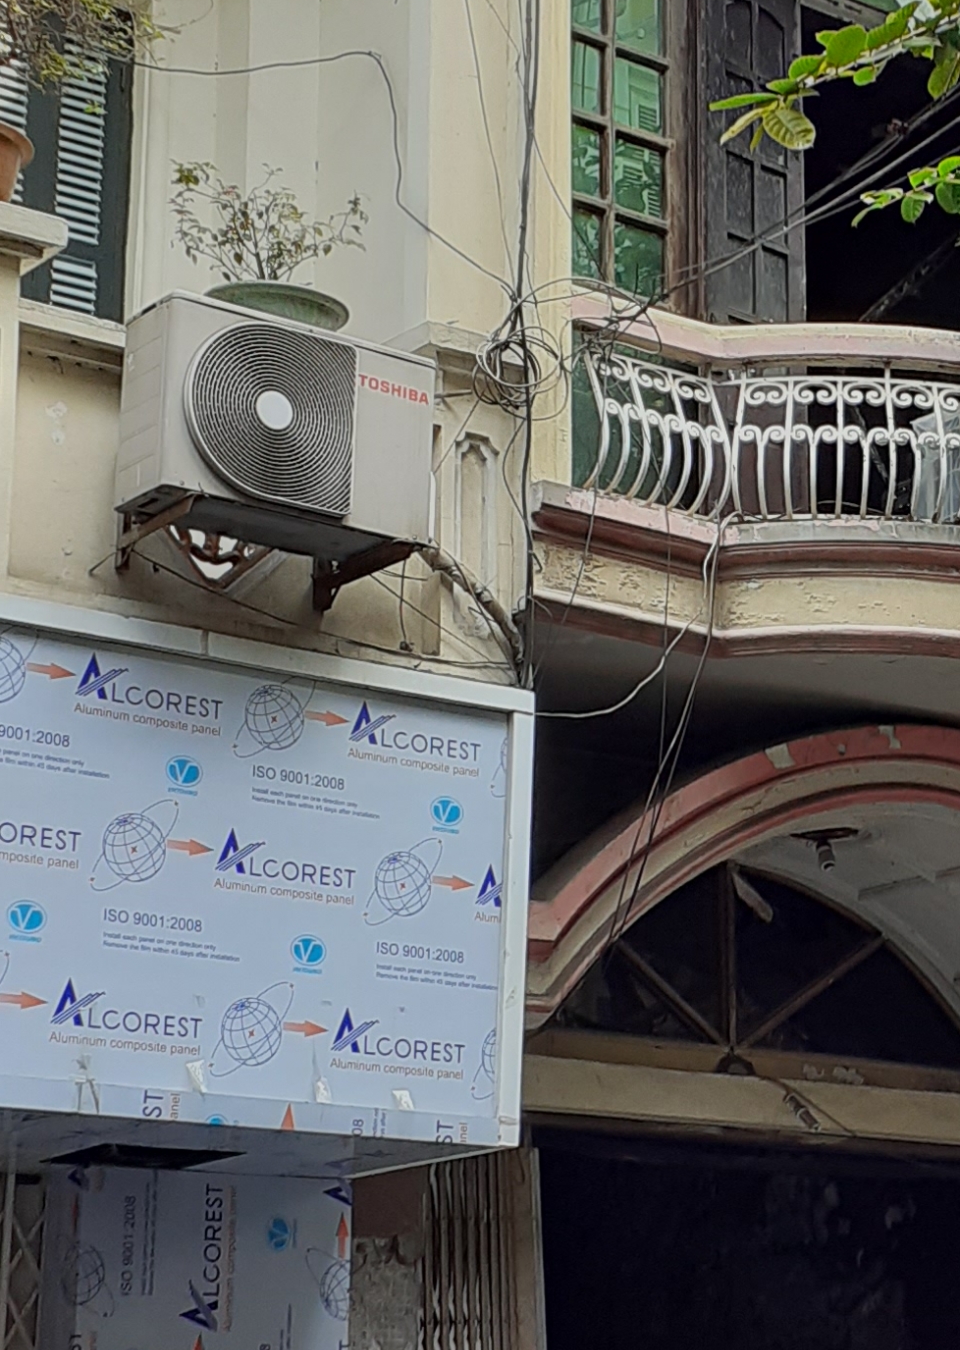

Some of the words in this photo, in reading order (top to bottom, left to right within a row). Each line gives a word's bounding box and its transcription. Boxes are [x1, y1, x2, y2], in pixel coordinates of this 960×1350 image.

[358, 373, 429, 406] TOSHIBA
[75, 652, 223, 720] ALCOREST
[73, 702, 130, 723] Aluminum
[133, 714, 188, 733] composite
[191, 724, 221, 737] panel
[348, 701, 481, 762] ALCOREST
[252, 764, 277, 780] ISO
[280, 769, 345, 790] 9001:2008
[348, 748, 398, 765] Aluminum
[400, 757, 450, 776] composite
[452, 765, 480, 777] panel
[47, 858, 79, 869] panel
[215, 828, 356, 888] ALCOREST
[214, 877, 267, 895] Aluminum
[270, 886, 323, 906] composite
[326, 894, 355, 906] panel
[103, 908, 129, 923] ISO
[133, 912, 203, 933] 9001:2008
[376, 941, 400, 956] ISO
[402, 944, 465, 964] 9001:2008
[50, 977, 203, 1039] ALCOREST
[49, 1031, 107, 1048] Aluminum
[110, 1038, 167, 1055] composite
[170, 1045, 201, 1057] panel
[330, 1007, 466, 1064] ALCOREST
[330, 1058, 381, 1073] Aluminum
[383, 1063, 434, 1078] composite
[437, 1069, 464, 1081] panel
[179, 1183, 224, 1332] ALCOREST
